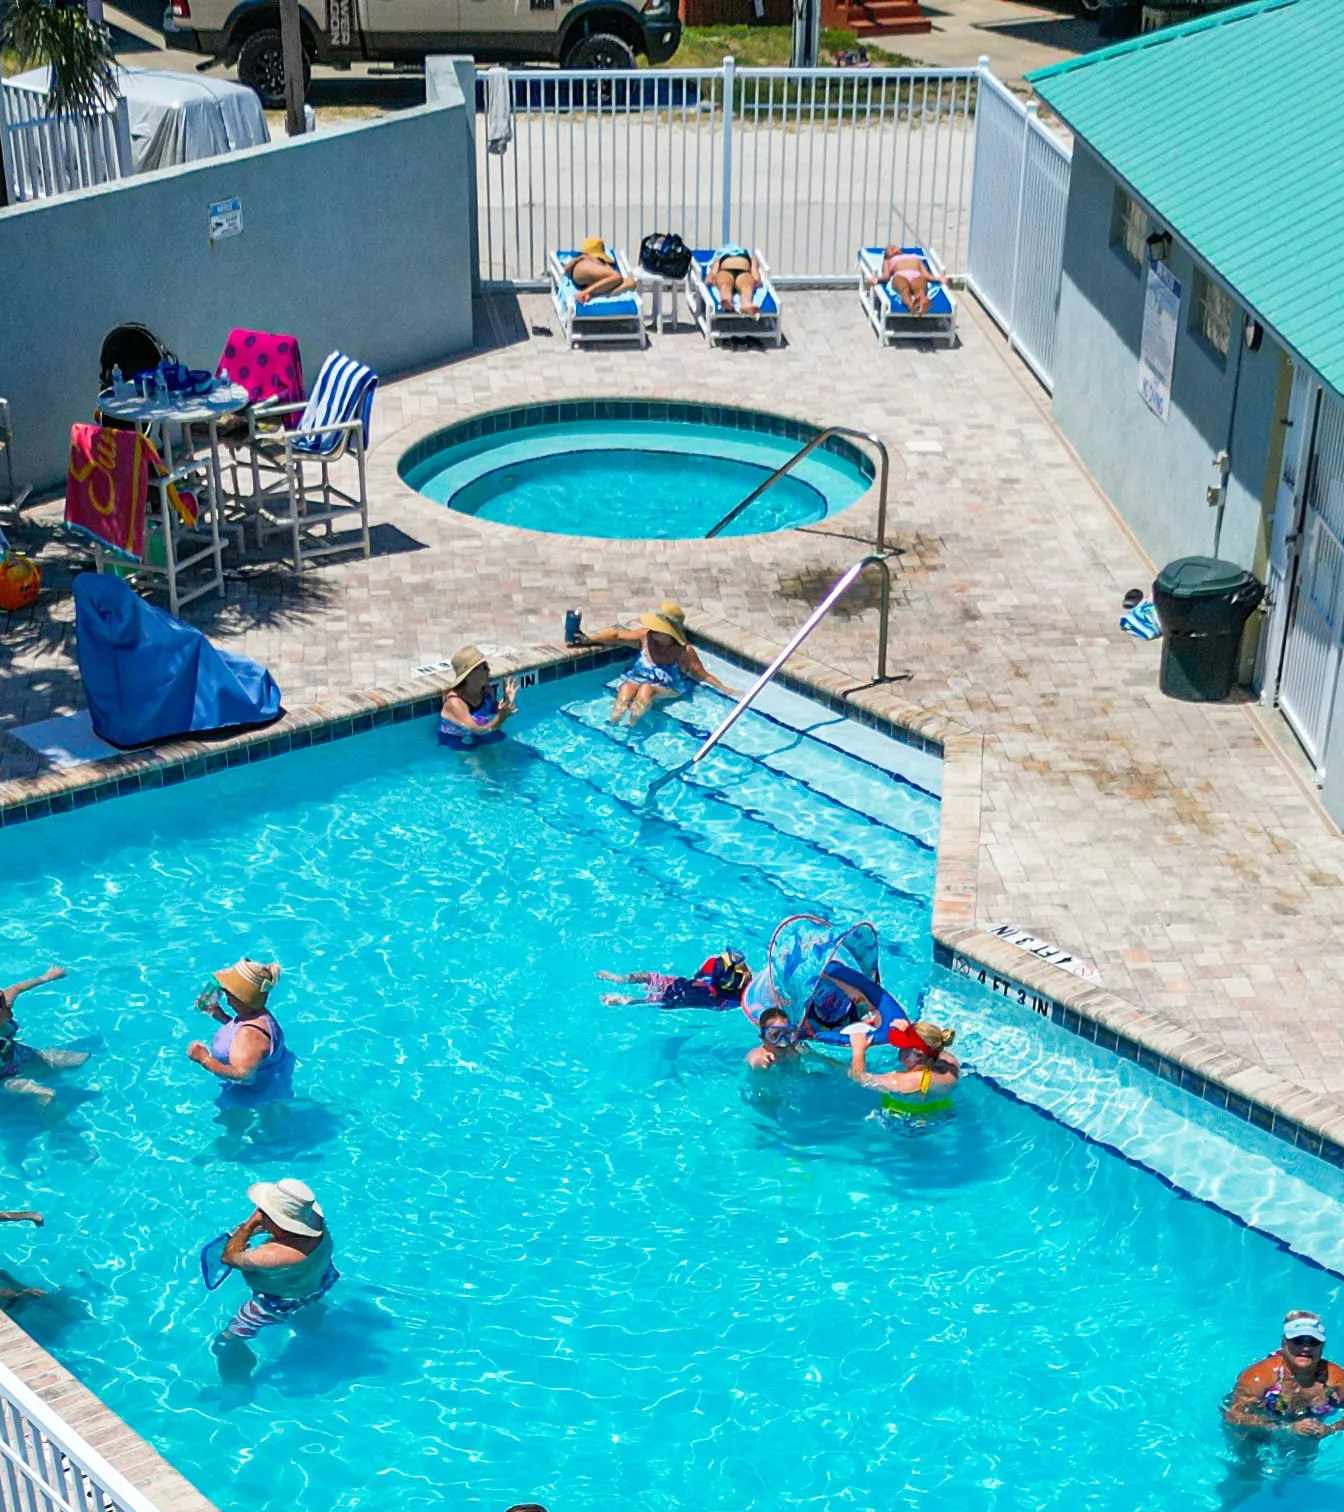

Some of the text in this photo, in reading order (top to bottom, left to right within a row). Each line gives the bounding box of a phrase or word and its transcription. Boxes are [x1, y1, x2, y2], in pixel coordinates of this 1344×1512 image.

[521, 673, 536, 689] IN
[990, 925, 1019, 939] IN
[1029, 945, 1060, 958] FT
[977, 969, 987, 985] 4
